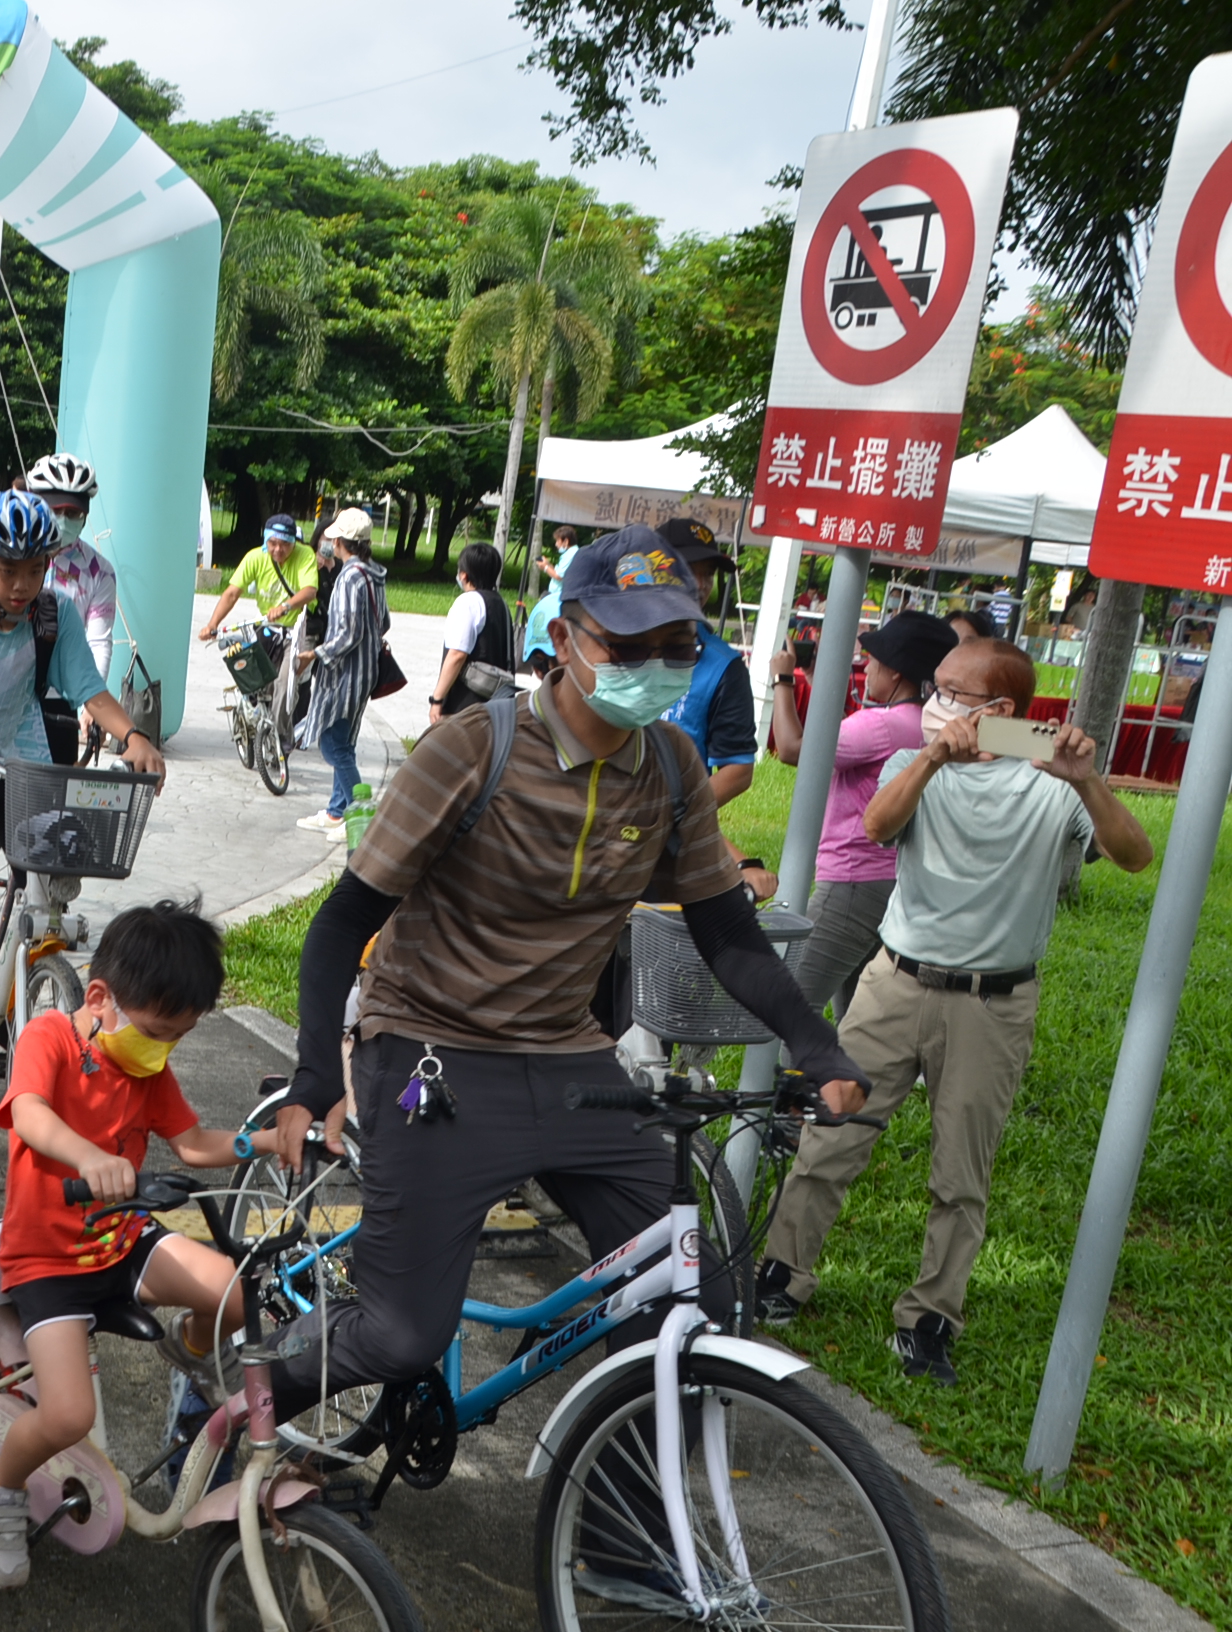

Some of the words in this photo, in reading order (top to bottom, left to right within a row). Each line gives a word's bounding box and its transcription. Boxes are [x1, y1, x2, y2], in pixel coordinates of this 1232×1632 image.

[767, 432, 943, 501] 禁止擺攤
[1117, 446, 1232, 522] 禁止
[819, 514, 897, 548] 新營公所
[903, 524, 925, 551] 製
[1203, 554, 1232, 588] 新
[538, 1299, 610, 1364] RIDER
